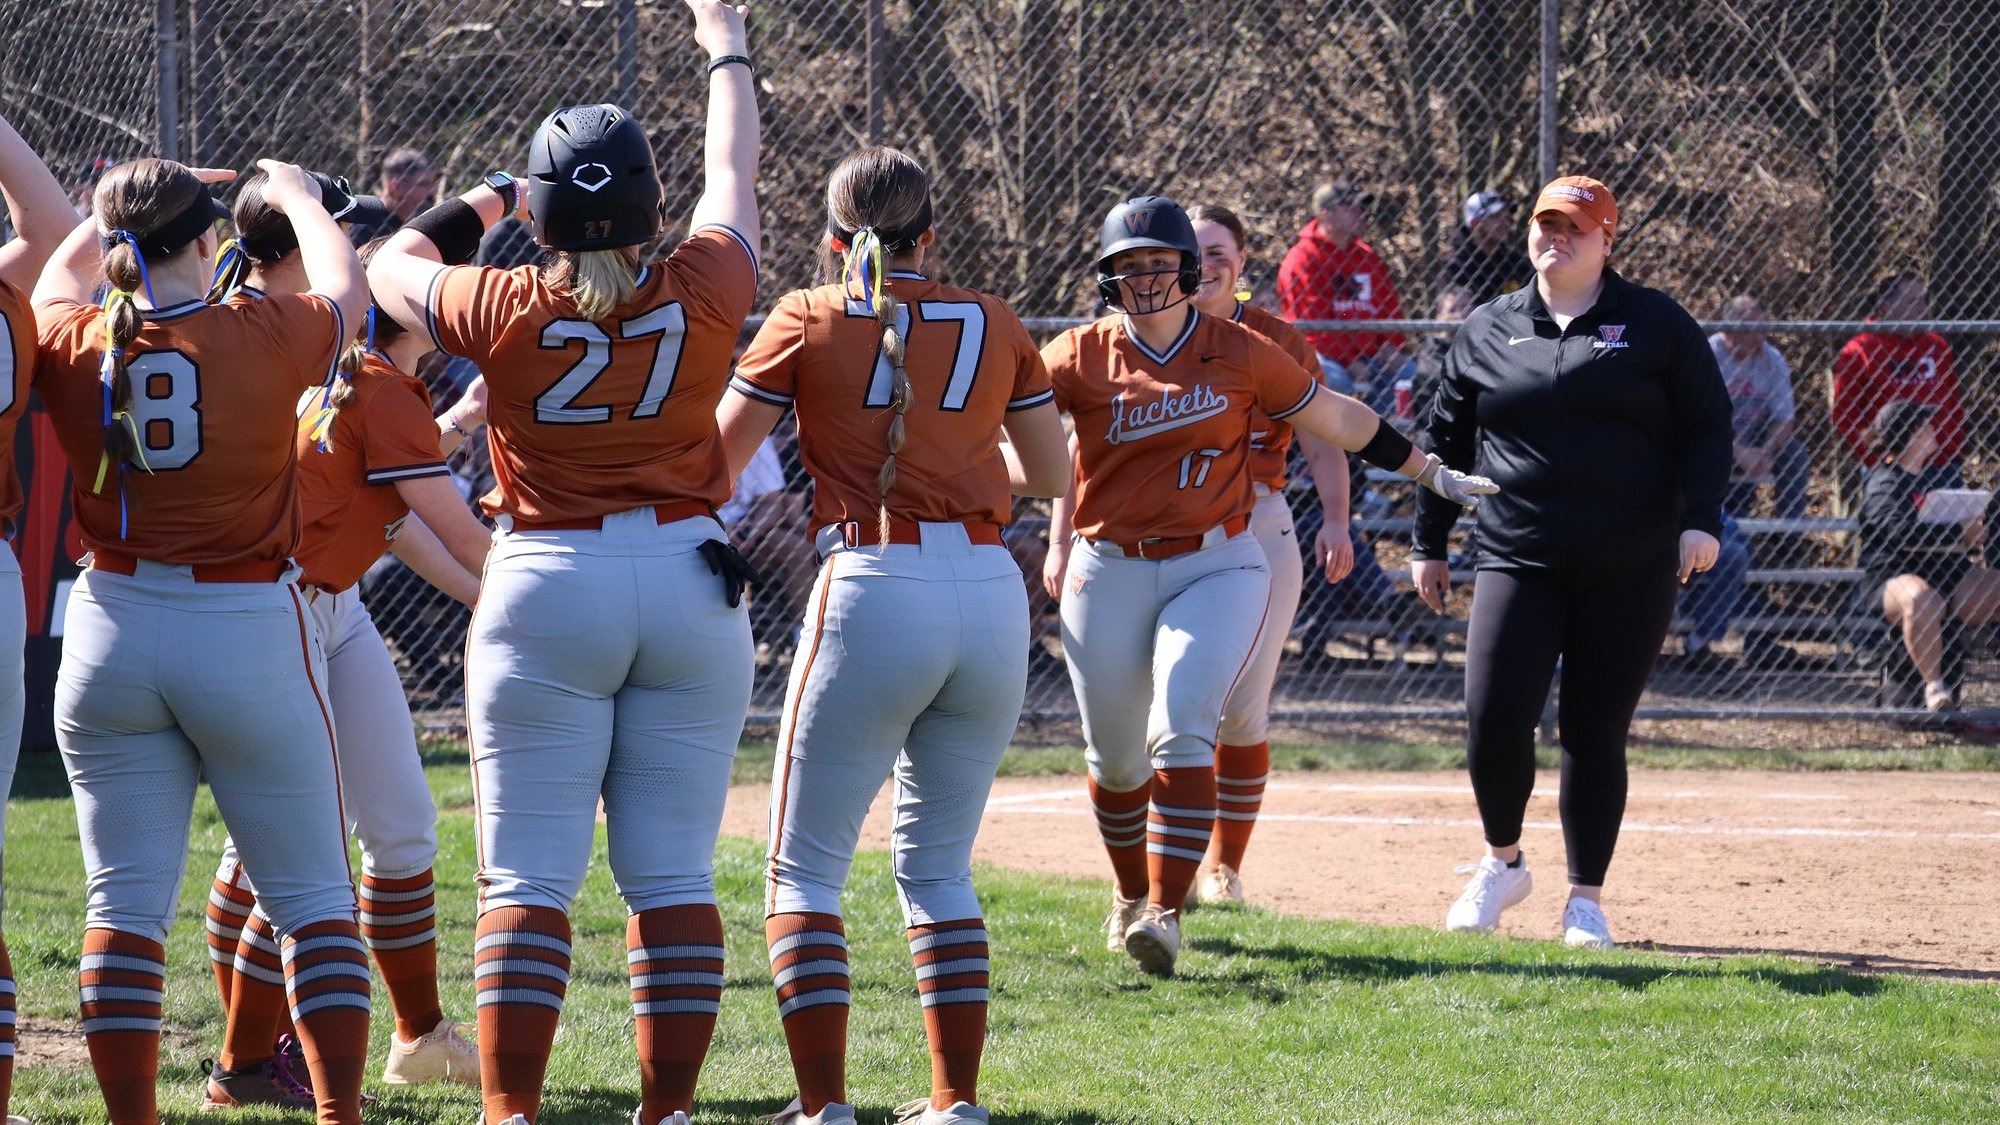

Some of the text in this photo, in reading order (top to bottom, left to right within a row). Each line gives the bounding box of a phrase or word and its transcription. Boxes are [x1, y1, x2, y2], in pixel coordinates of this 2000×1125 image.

[584, 220, 612, 239] 27
[1122, 209, 1156, 236] W
[844, 297, 988, 413] 77
[1599, 324, 1626, 343] W
[533, 299, 689, 426] 27
[124, 347, 204, 473] 8
[1104, 384, 1229, 446] Jackets
[1177, 448, 1224, 491] 17
